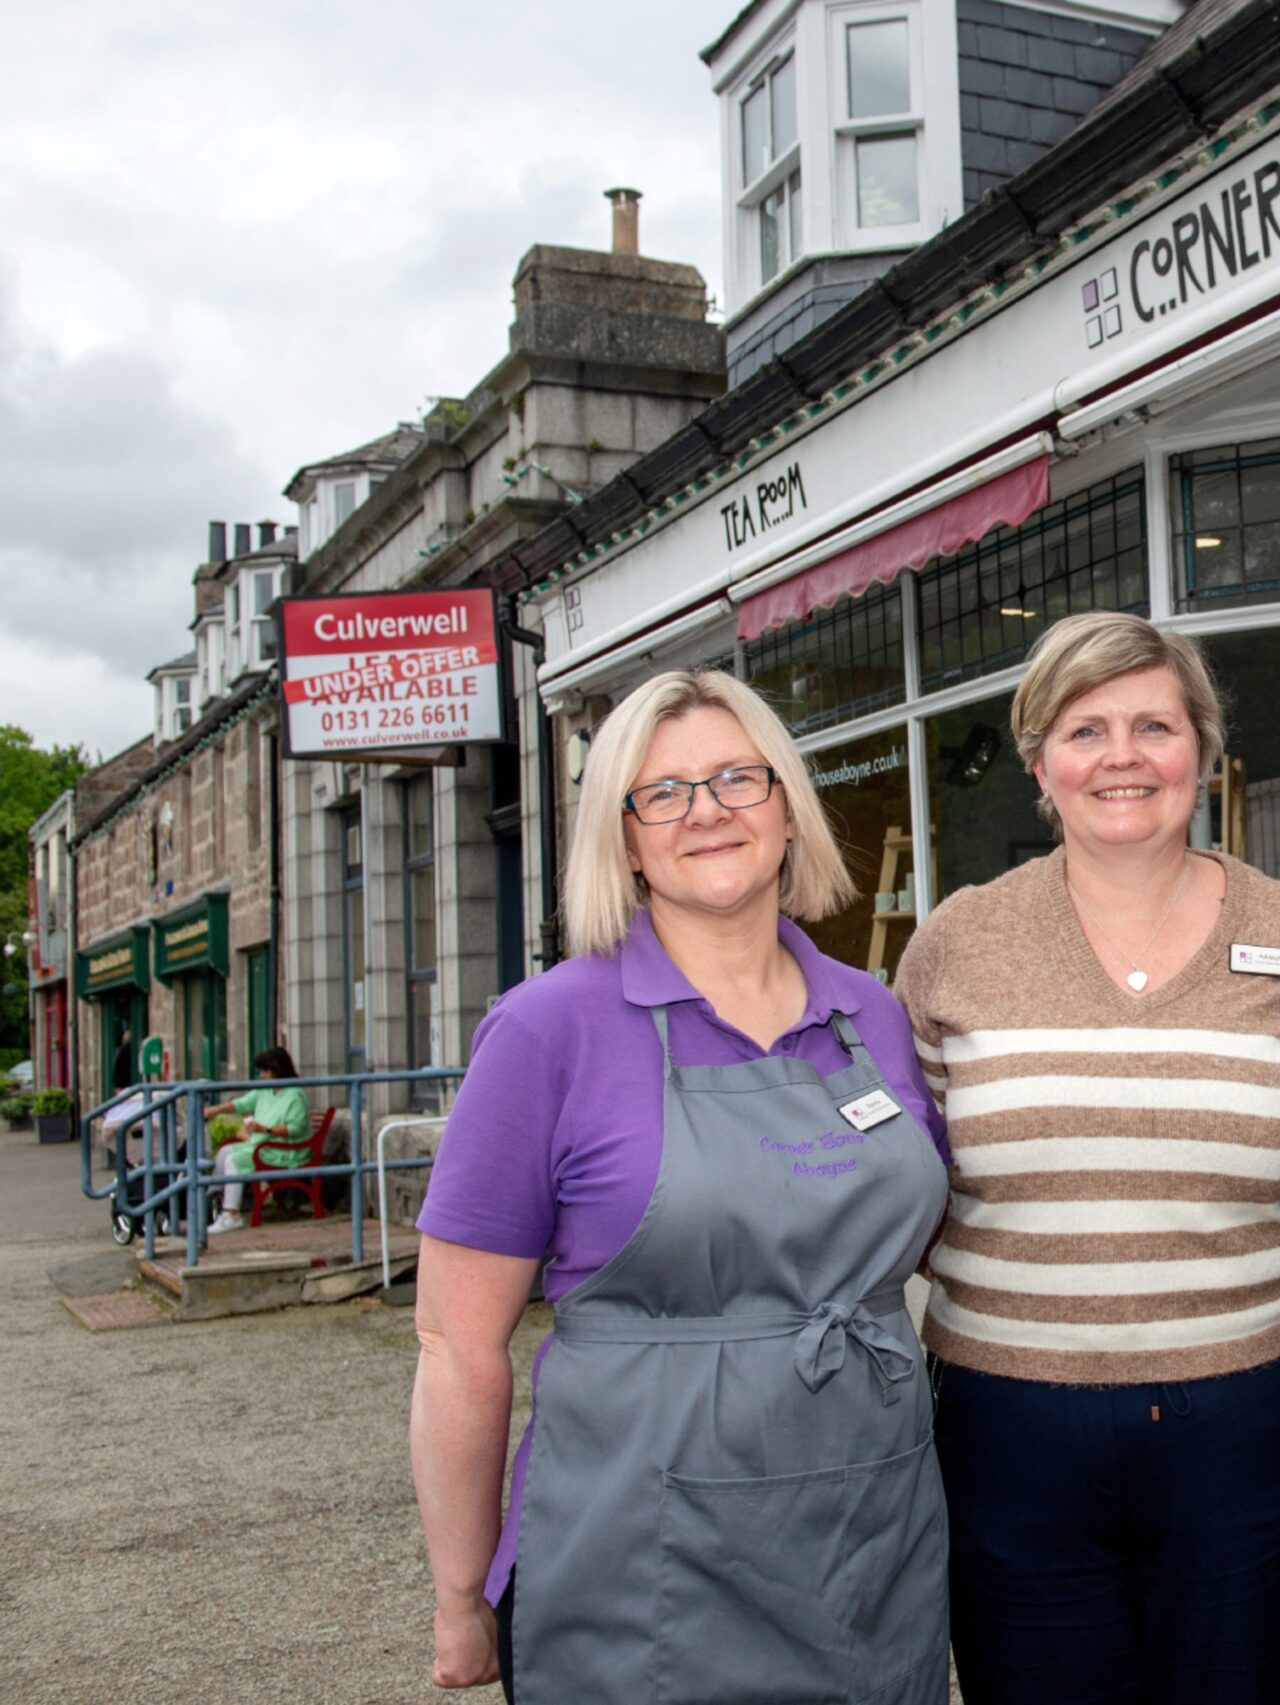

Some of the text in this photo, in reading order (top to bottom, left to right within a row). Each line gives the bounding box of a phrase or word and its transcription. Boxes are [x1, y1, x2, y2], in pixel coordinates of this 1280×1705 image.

[720, 461, 807, 552] TEA ROOM
[314, 605, 468, 642] Culverwell
[303, 662, 395, 698] UNDER
[401, 646, 480, 679] OFFER
[321, 702, 470, 732] 0131 226 6611
[322, 726, 469, 748] www.culverwell.co.uk
